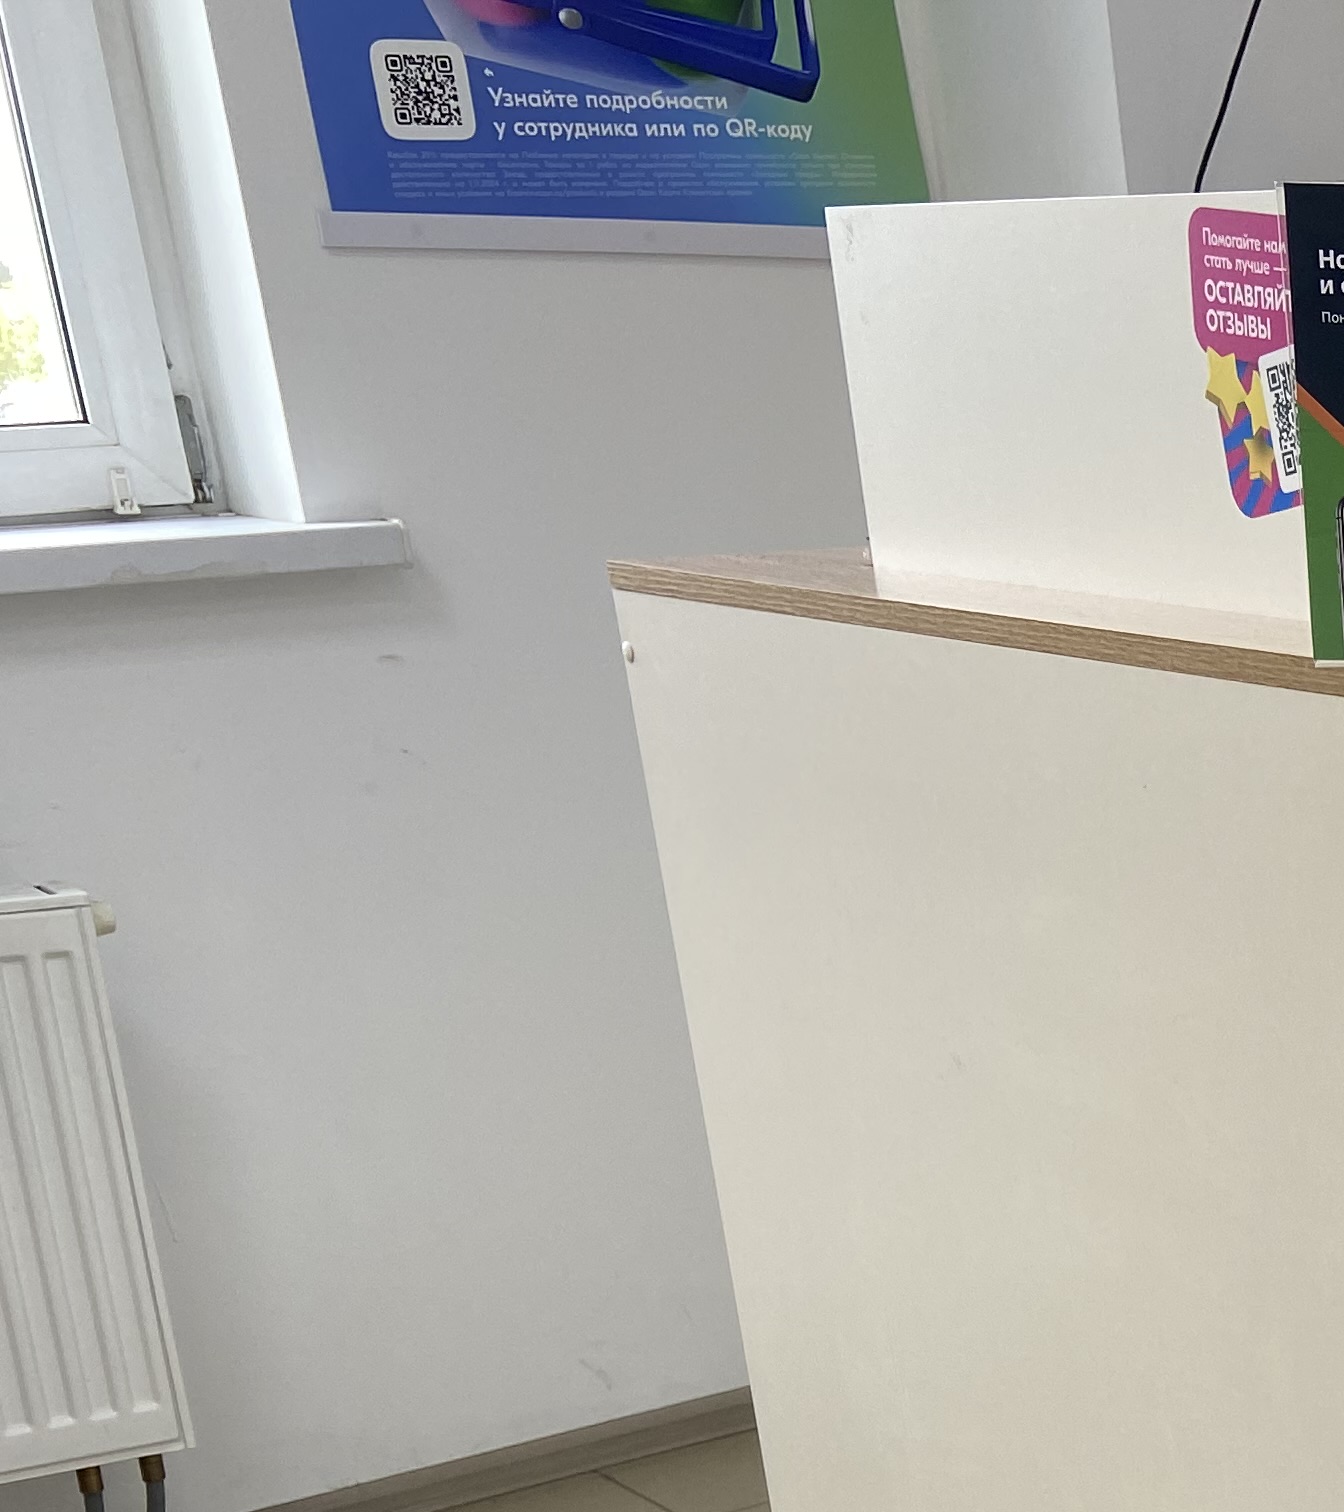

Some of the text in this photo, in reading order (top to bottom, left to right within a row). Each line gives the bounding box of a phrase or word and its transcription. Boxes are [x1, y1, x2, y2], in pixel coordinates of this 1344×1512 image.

[487, 87, 728, 113] Узнайте подробности
[493, 118, 813, 142] у сотрудника или по QR-коду
[1202, 227, 1261, 252] Помогайте
[1203, 254, 1232, 270] стать
[1235, 259, 1270, 277] лучше
[1319, 278, 1334, 295] и
[1206, 308, 1272, 340] ОТЗЫВЫ
